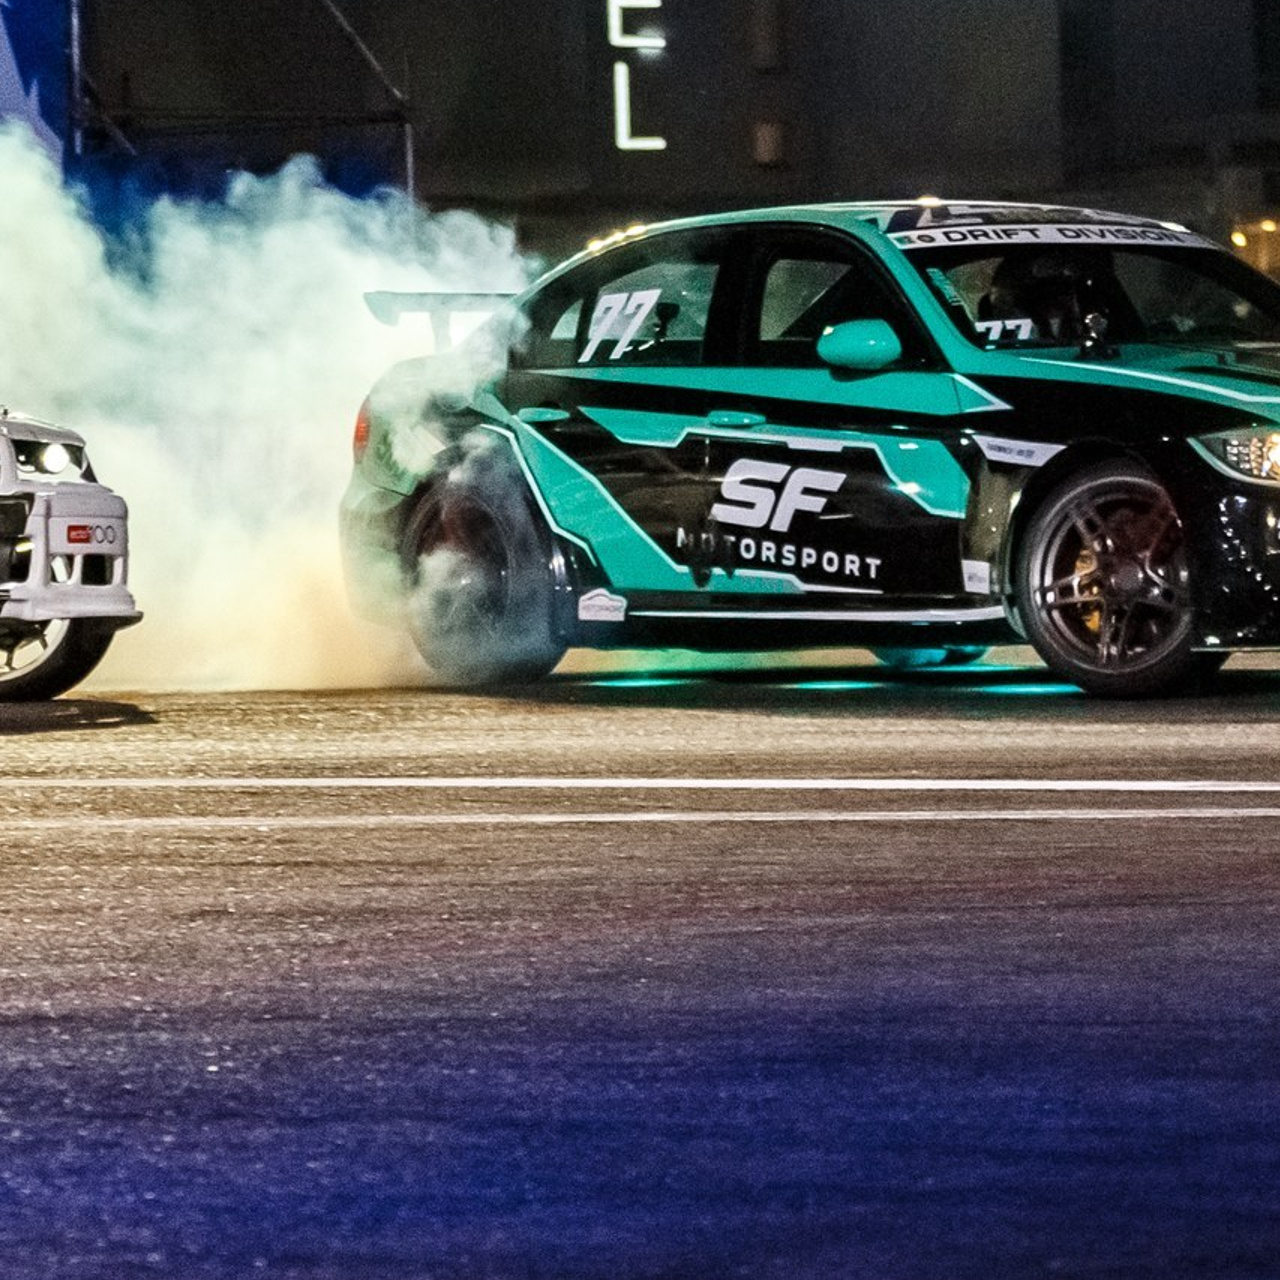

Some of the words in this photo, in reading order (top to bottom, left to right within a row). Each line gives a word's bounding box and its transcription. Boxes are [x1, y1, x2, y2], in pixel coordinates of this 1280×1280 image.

[941, 228, 1040, 242] DRIFT
[1056, 228, 1186, 244] DIVISION
[577, 289, 662, 363] 77
[708, 458, 847, 532] SF
